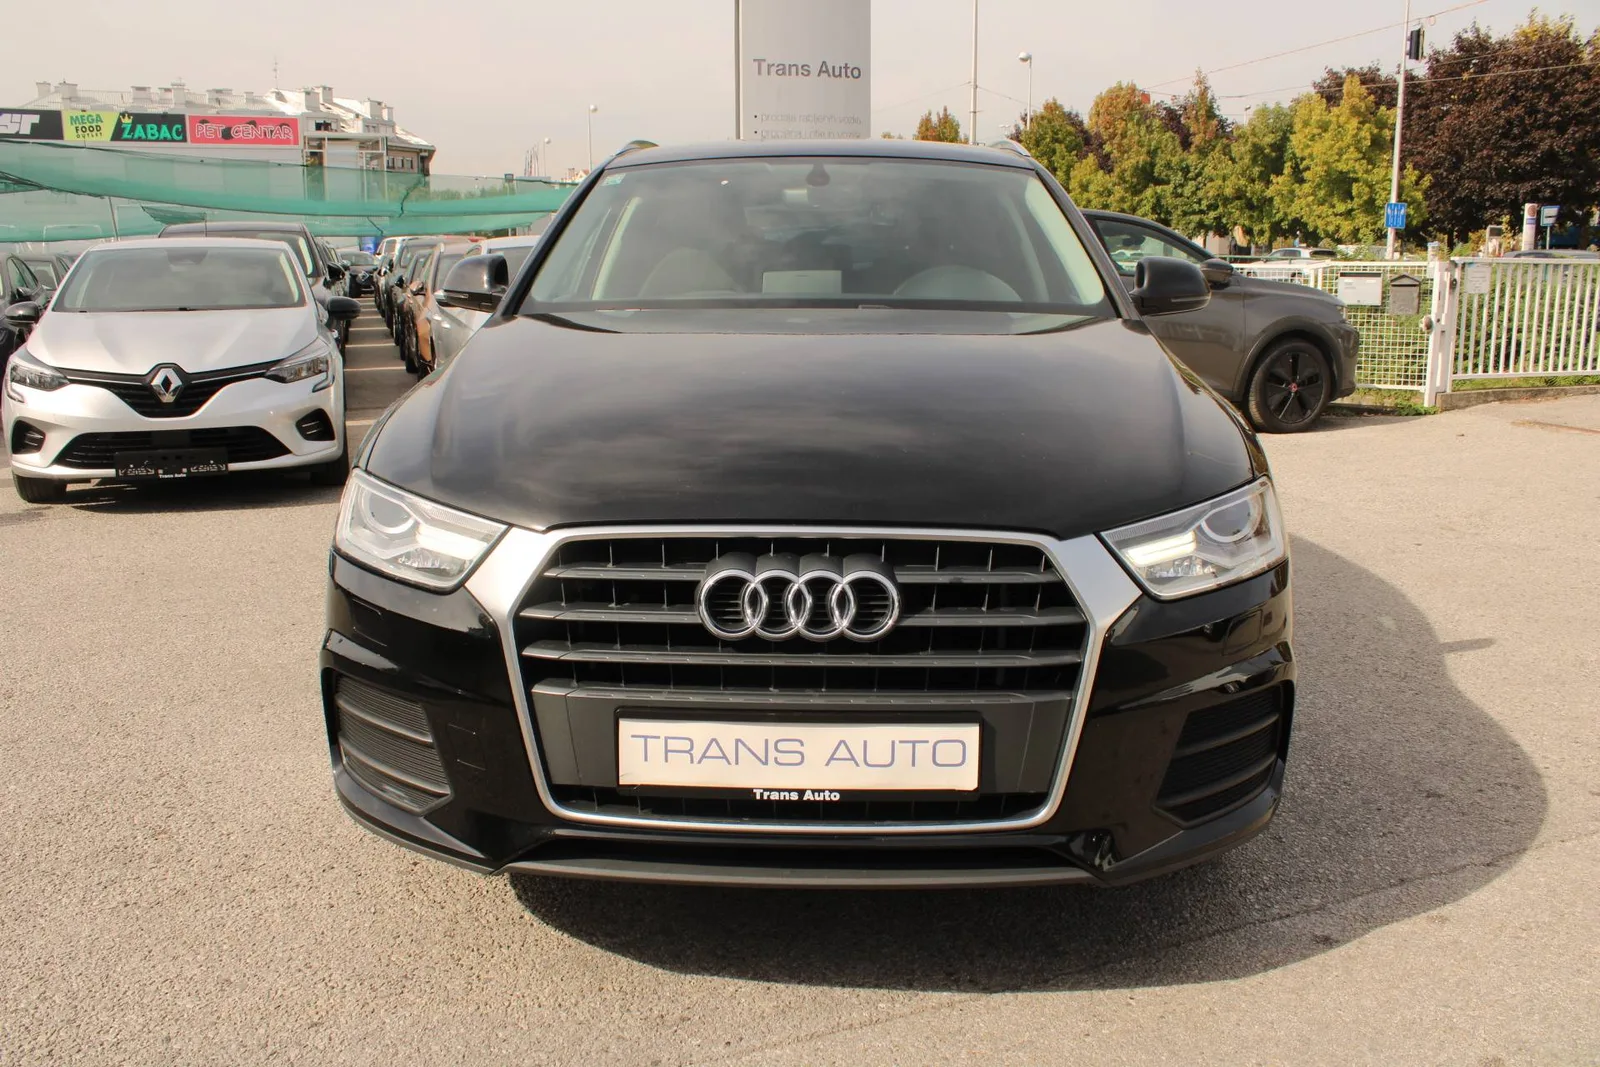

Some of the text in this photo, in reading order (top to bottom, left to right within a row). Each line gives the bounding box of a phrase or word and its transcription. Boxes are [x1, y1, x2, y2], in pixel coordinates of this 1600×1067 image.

[752, 58, 862, 79] Trans Auto
[69, 114, 103, 126] MEGA
[75, 125, 102, 133] FOOD
[195, 123, 293, 139] PET CENTAR
[631, 734, 966, 768] TRANS AUTO
[753, 788, 840, 801] Trans Auto
